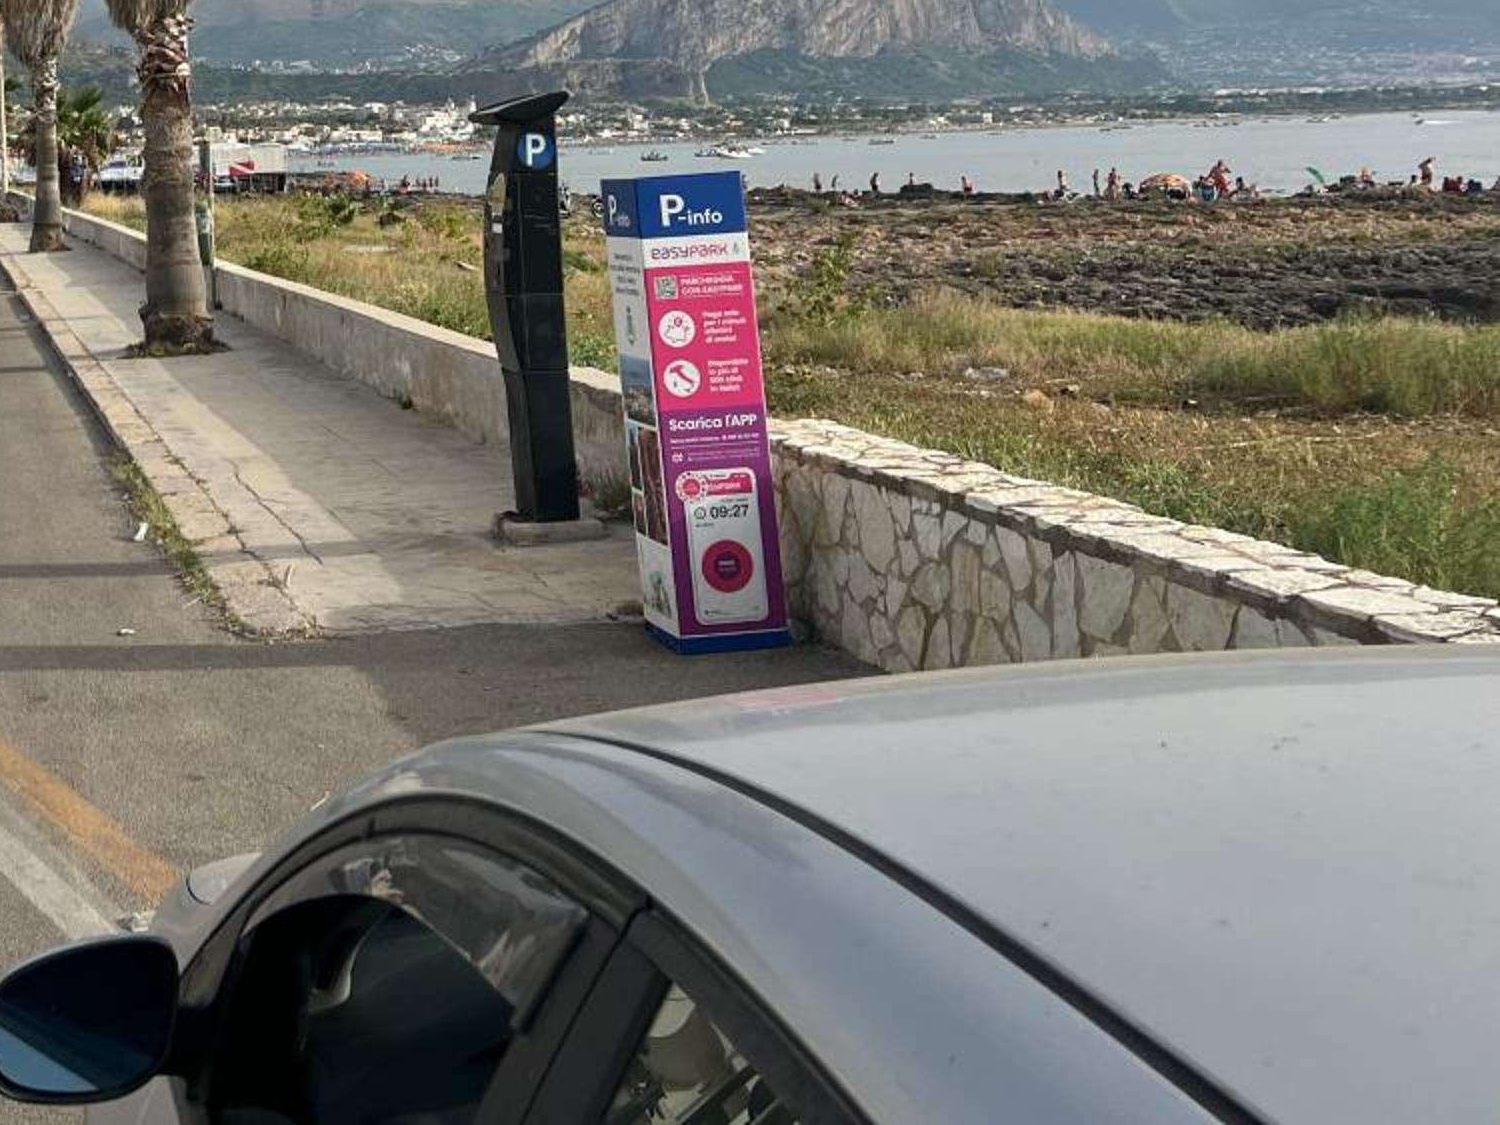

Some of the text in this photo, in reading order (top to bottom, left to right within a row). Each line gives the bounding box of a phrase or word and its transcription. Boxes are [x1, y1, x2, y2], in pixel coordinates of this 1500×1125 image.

[525, 133, 546, 167] P
[659, 194, 723, 227] P-info
[668, 416, 722, 431] Scarica
[709, 504, 749, 520] 09:27
